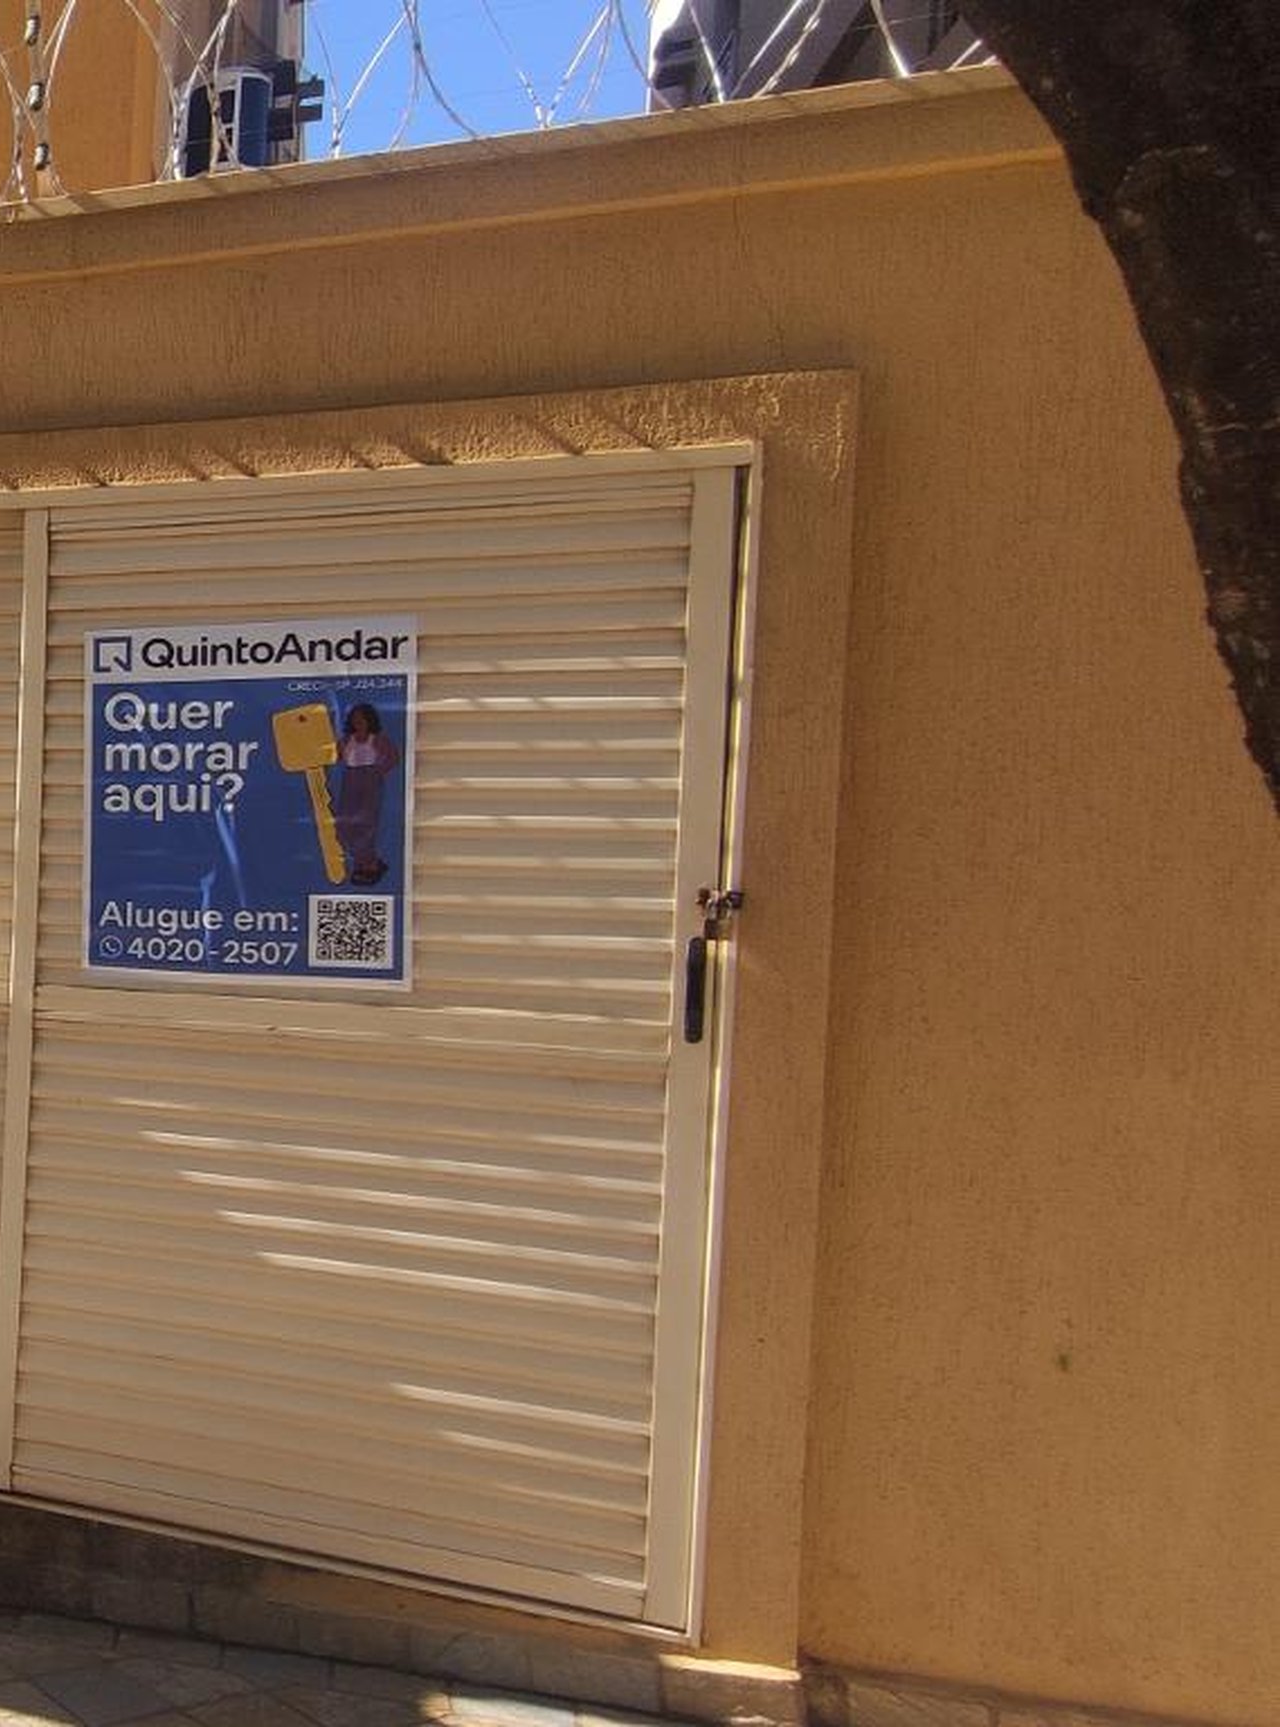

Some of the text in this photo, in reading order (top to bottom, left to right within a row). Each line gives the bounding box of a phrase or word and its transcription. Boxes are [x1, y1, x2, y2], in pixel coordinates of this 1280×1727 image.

[141, 630, 409, 668] QuintoAndar
[104, 692, 234, 731] Quer
[105, 741, 259, 772] morar
[103, 772, 245, 822] aqui?
[99, 901, 299, 935] Alugue em:
